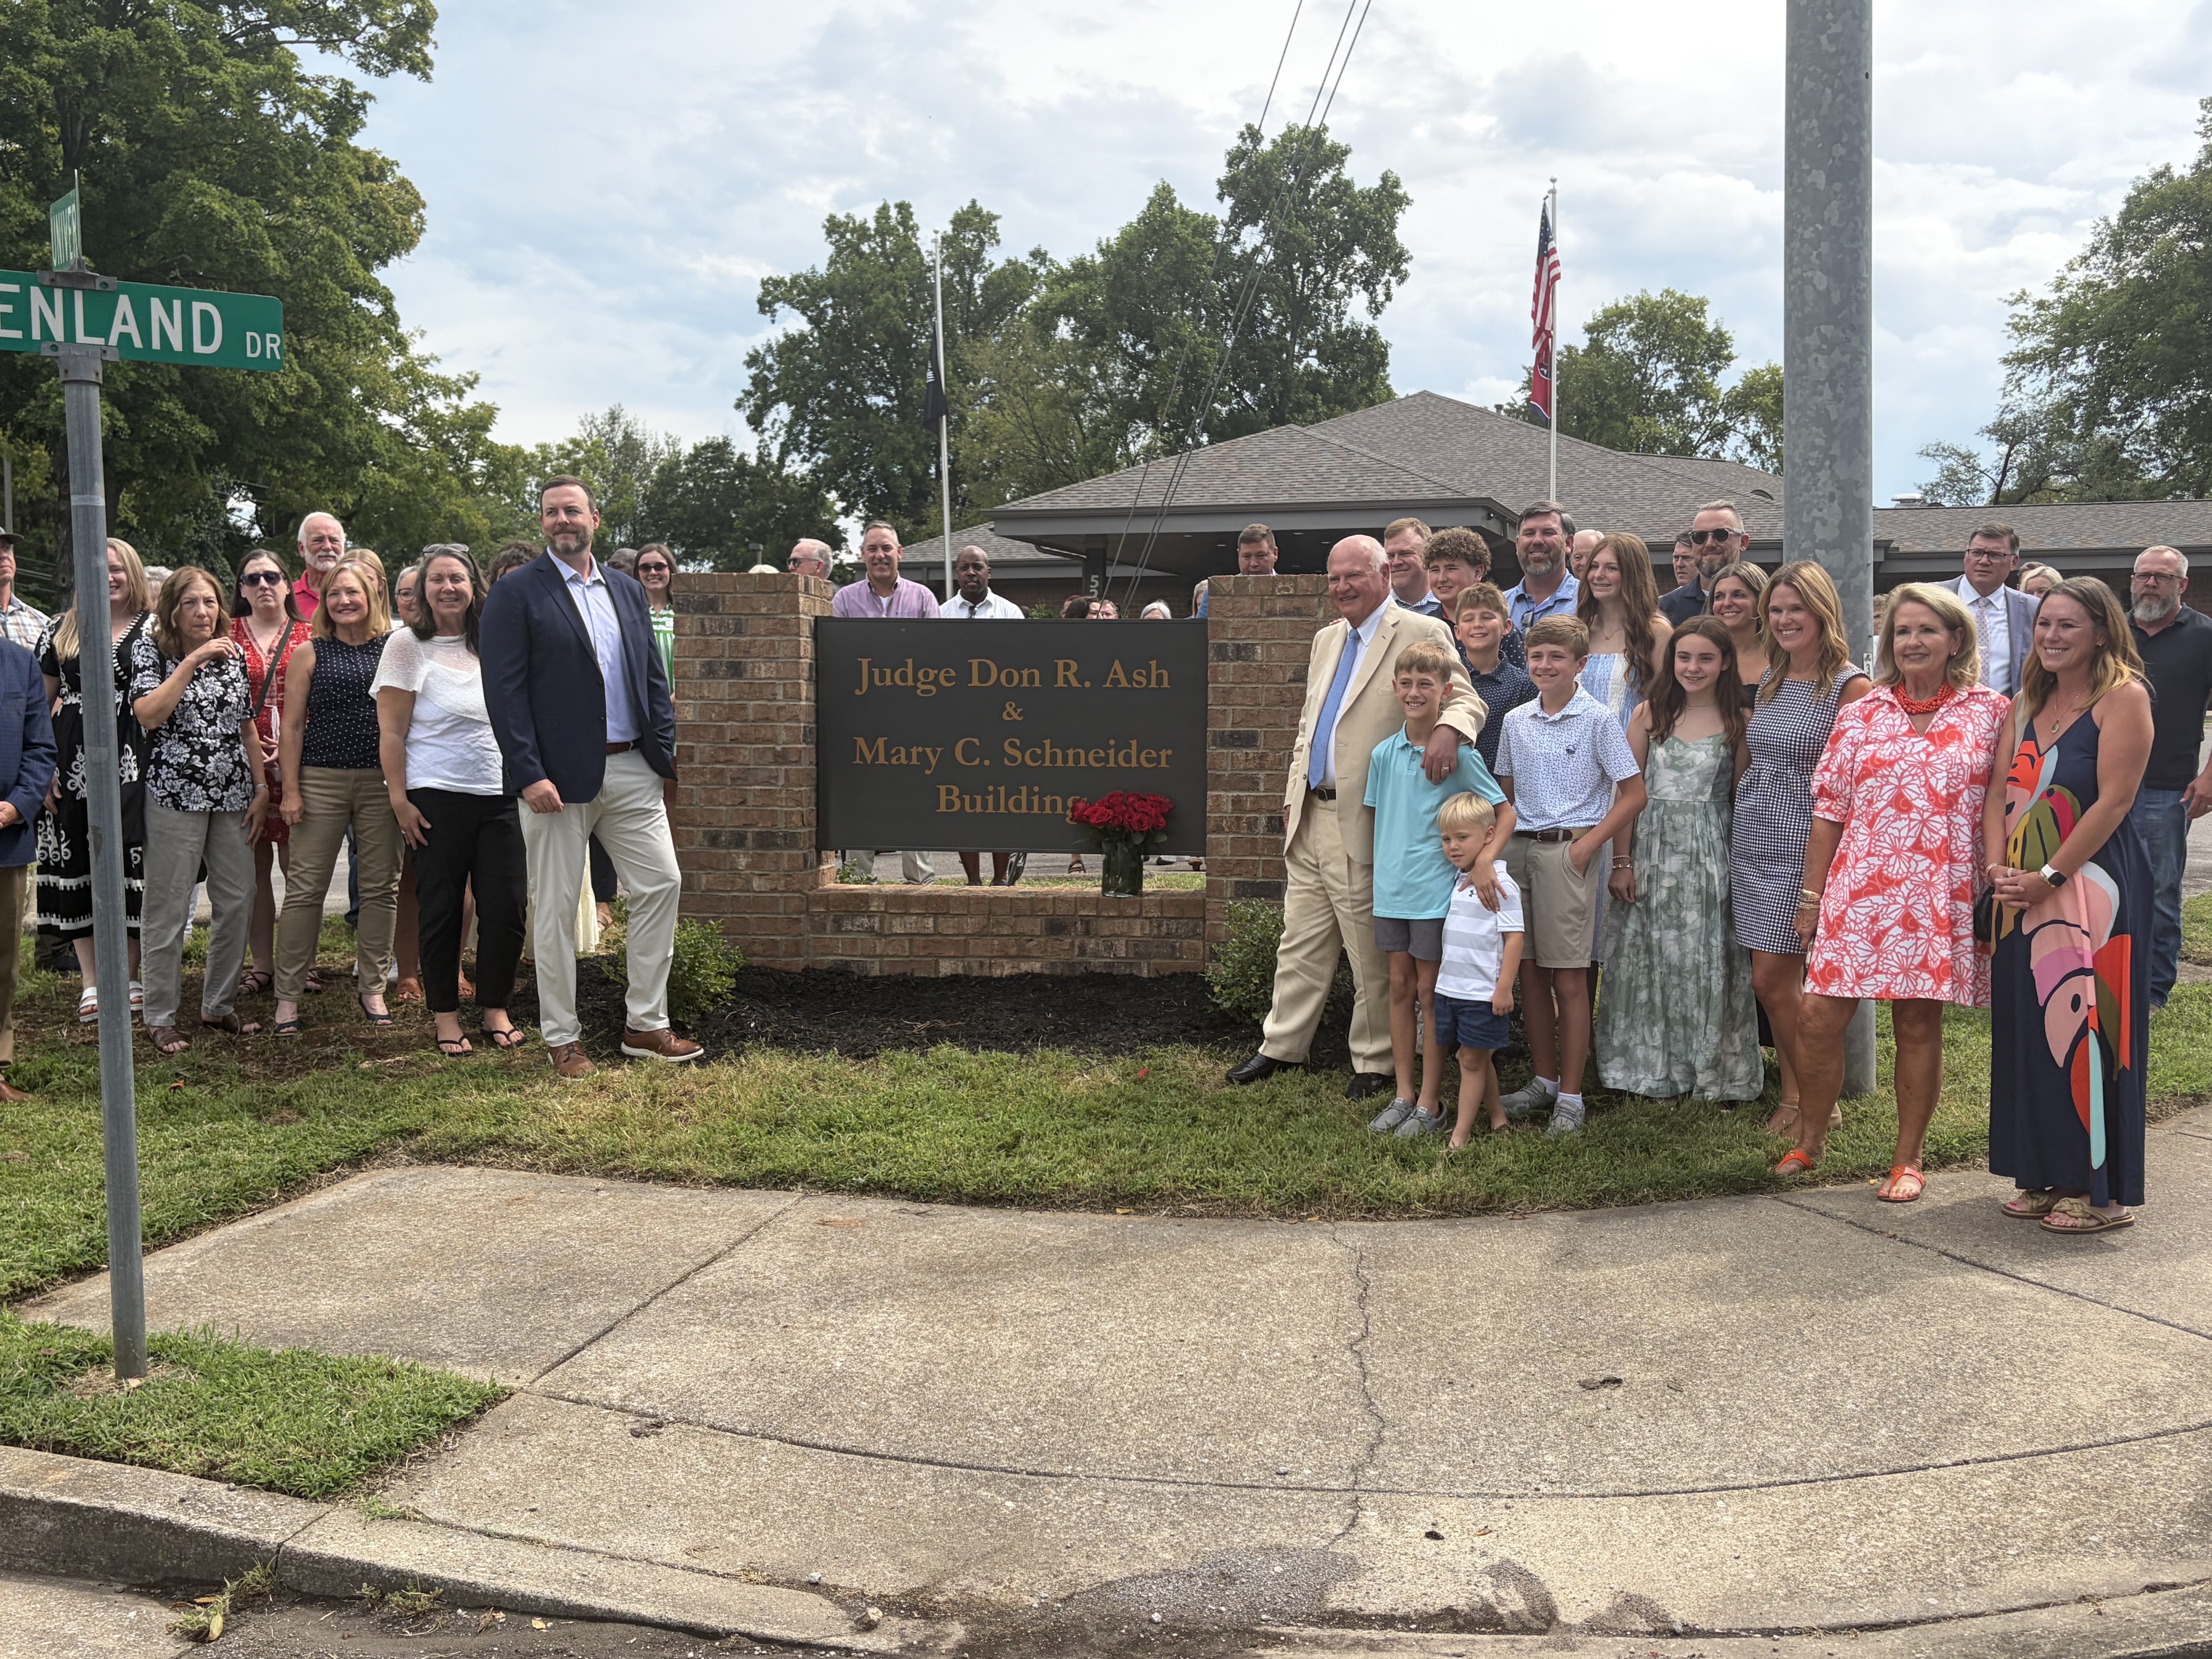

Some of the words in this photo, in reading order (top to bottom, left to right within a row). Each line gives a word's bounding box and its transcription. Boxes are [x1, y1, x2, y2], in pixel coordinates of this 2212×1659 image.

[246, 331, 281, 359] DR
[855, 658, 956, 697] Judge
[968, 659, 1041, 687] Don
[1054, 659, 1091, 688] R.
[1103, 660, 1171, 688] Ash
[1002, 702, 1024, 721] &
[852, 737, 943, 775] Mary
[955, 738, 990, 766] C.
[1004, 738, 1173, 768] Schneider
